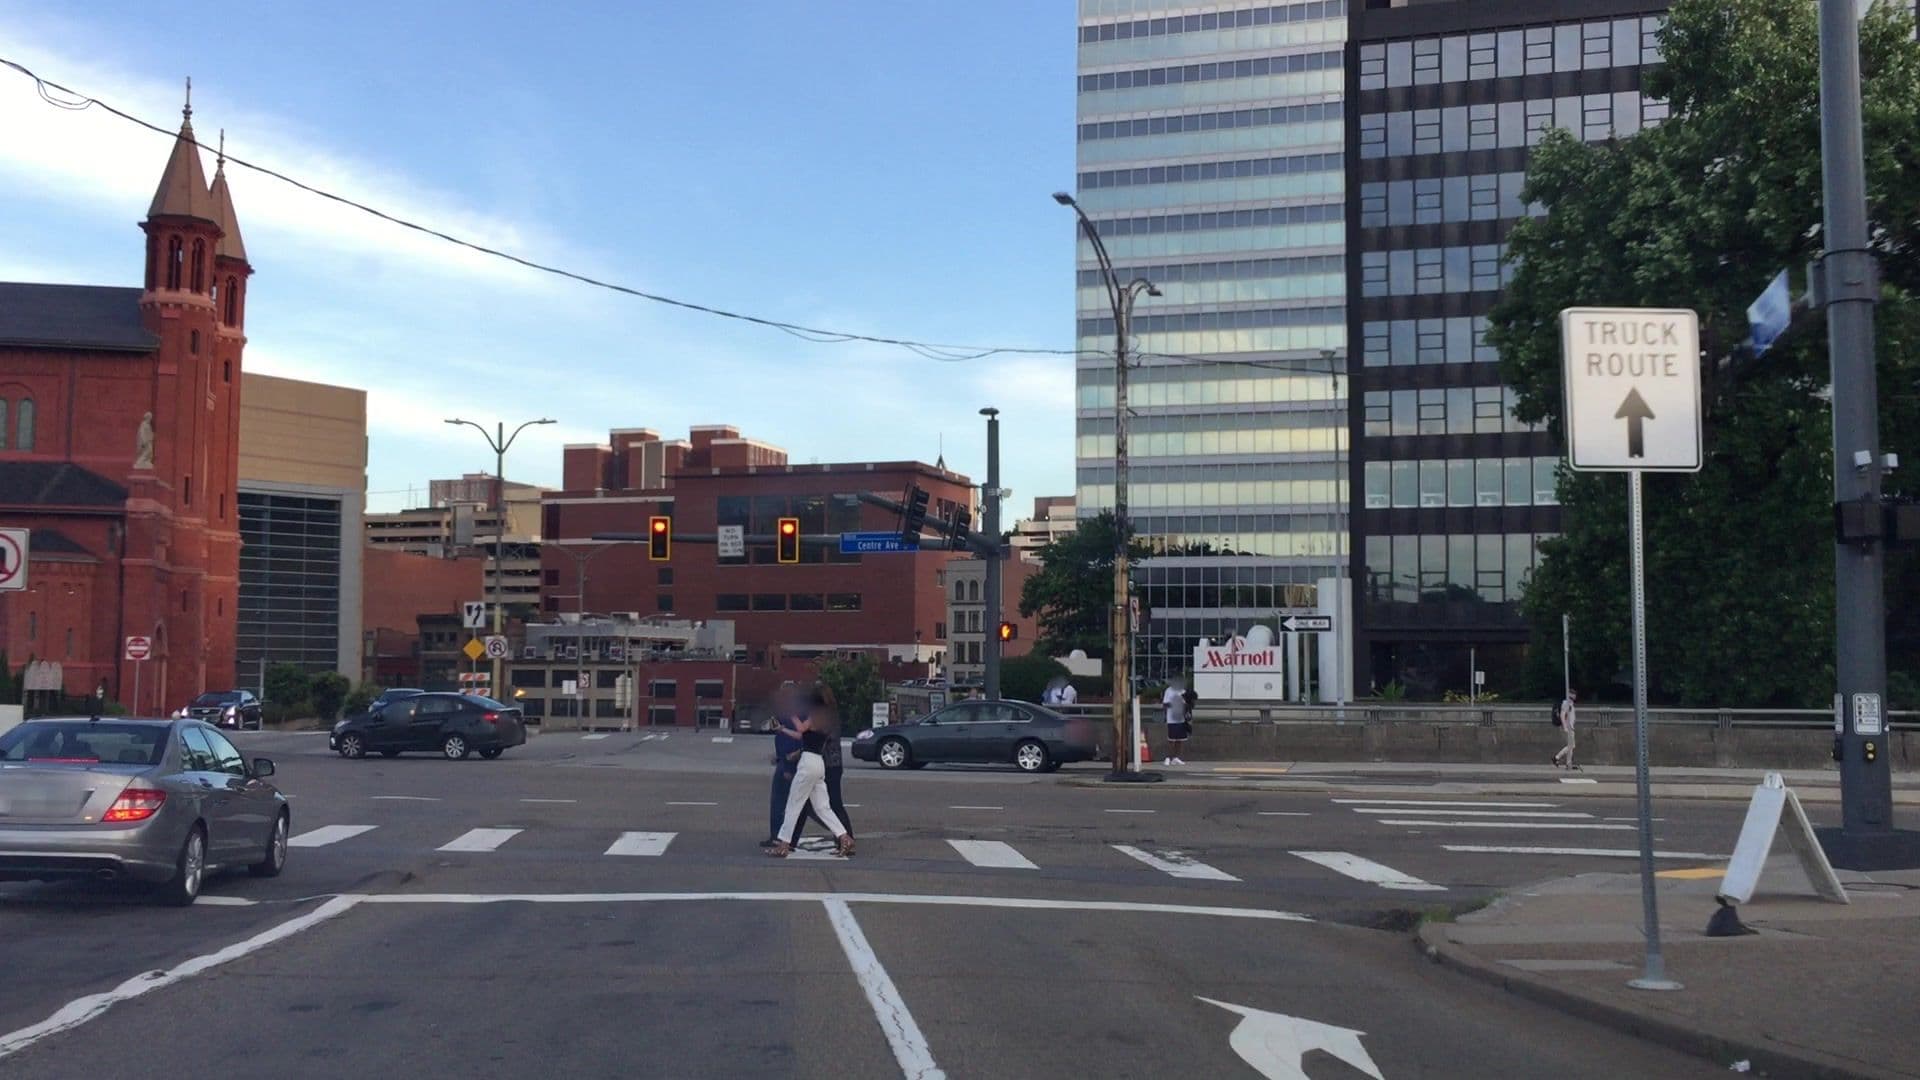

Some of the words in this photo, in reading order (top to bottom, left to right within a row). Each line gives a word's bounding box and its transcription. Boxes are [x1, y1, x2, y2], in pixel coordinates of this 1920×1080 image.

[1584, 321, 1678, 345] TRUCK
[1586, 353, 1678, 376] ROUTE
[857, 541, 882, 550] Centre
[885, 541, 899, 550] Ave
[1202, 650, 1274, 668] Marriott
